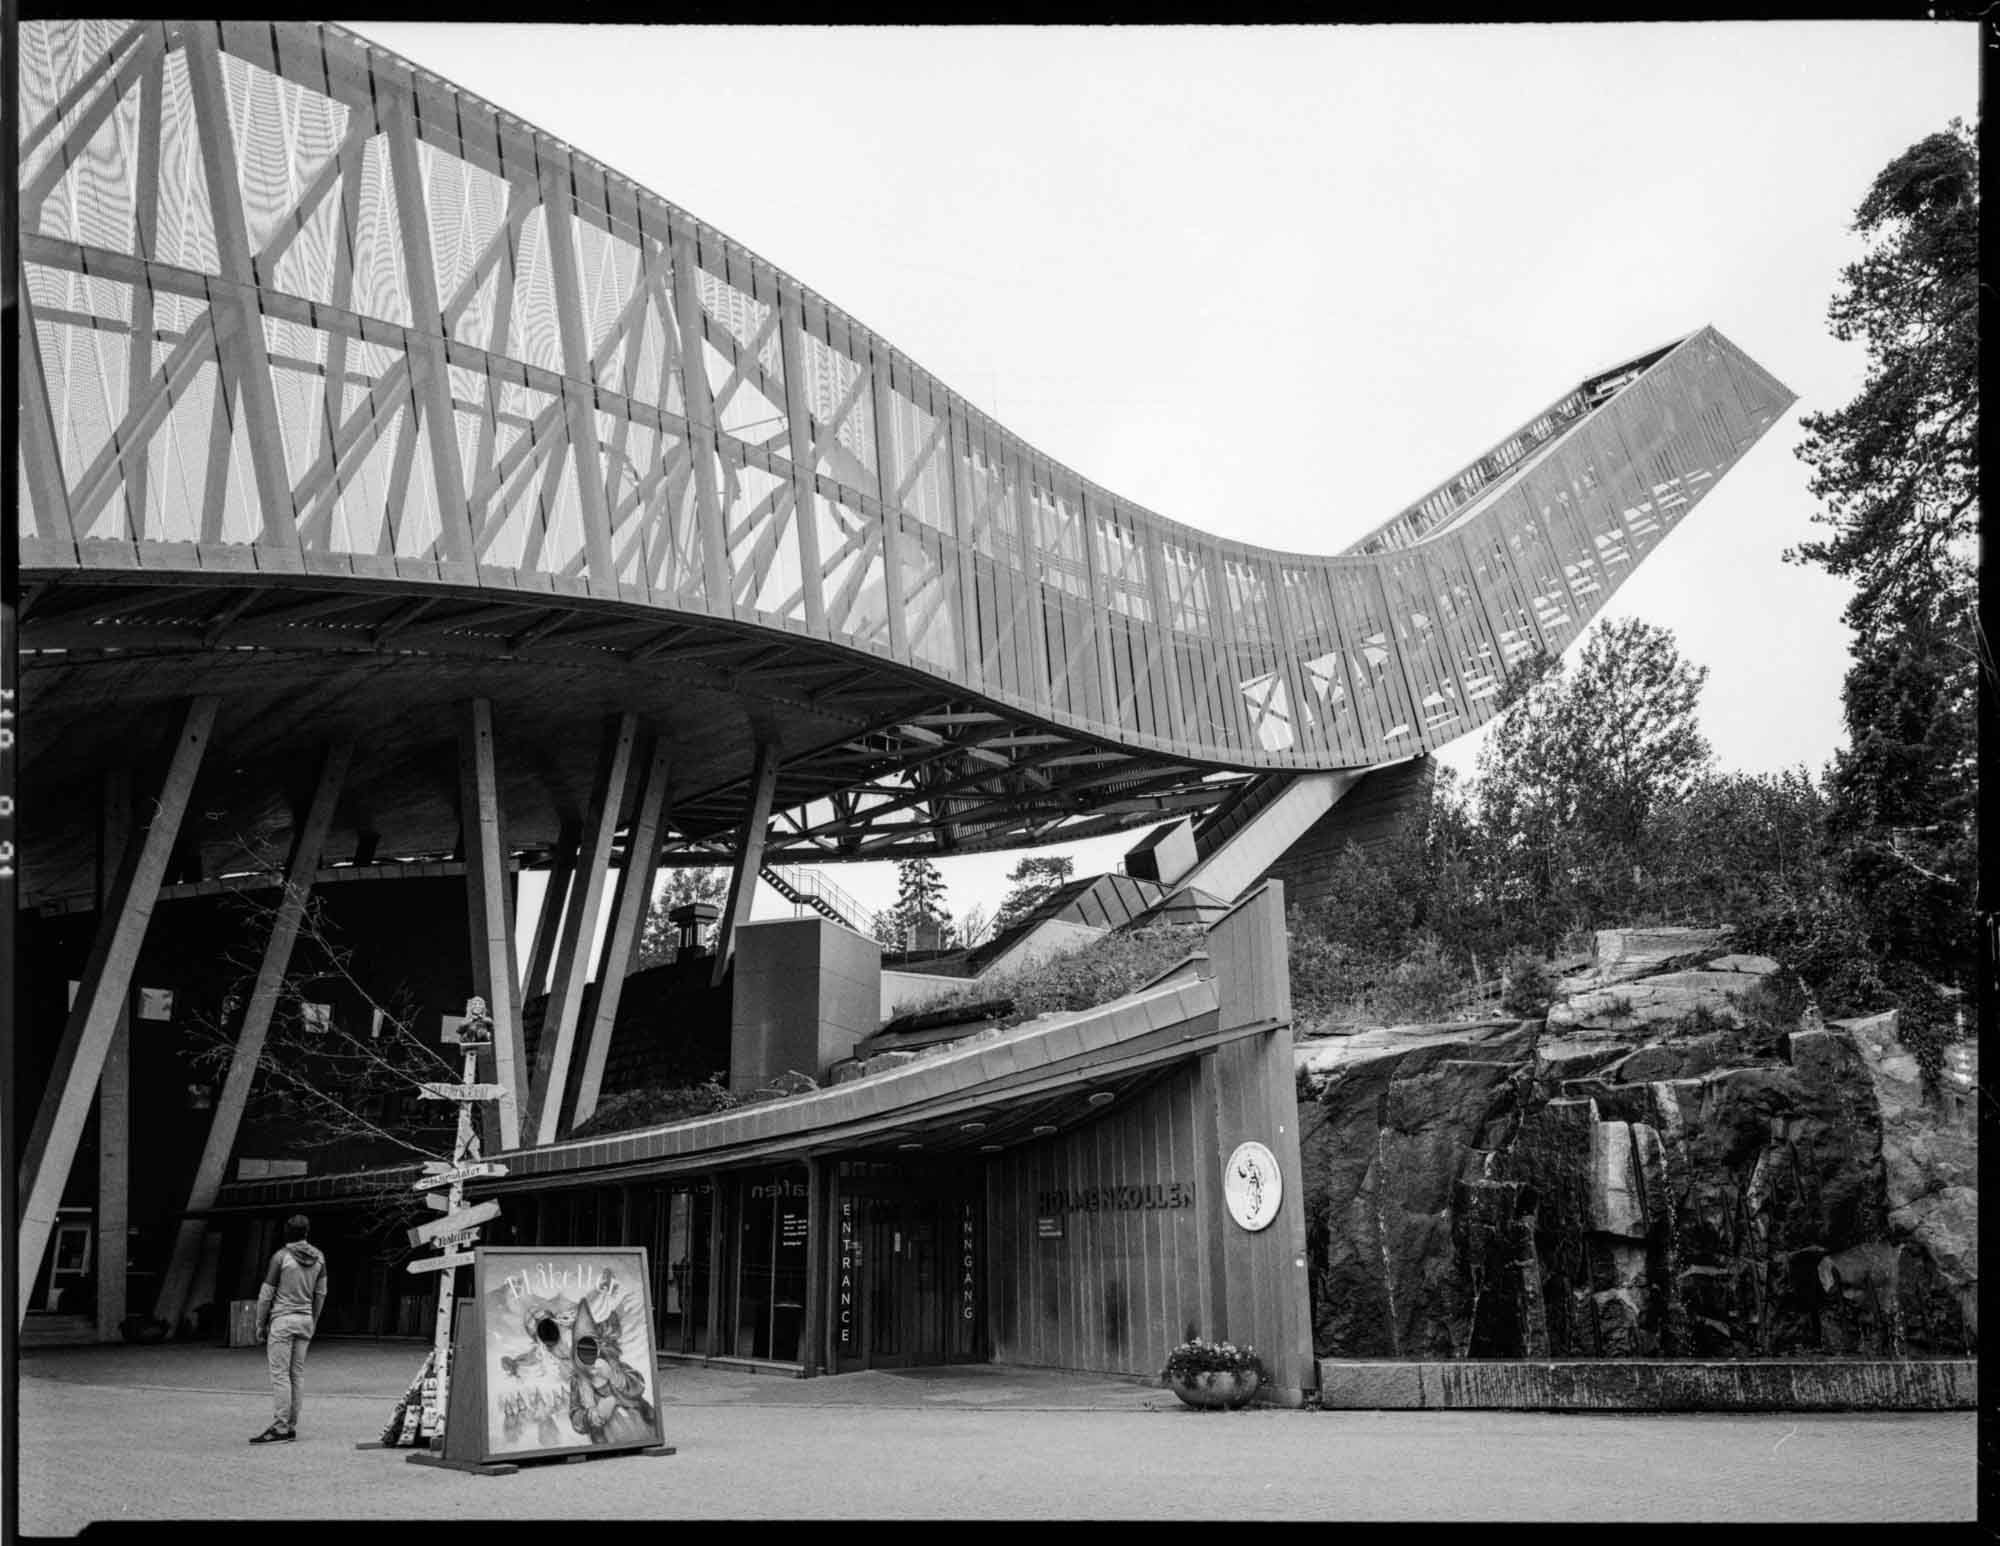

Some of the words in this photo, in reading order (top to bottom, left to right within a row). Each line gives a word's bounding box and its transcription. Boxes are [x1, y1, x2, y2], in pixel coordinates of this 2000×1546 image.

[1039, 1181, 1195, 1213] HOLMENKOLLEN
[841, 1203, 851, 1342] ENTRANCE
[964, 1204, 973, 1319] INNGANG
